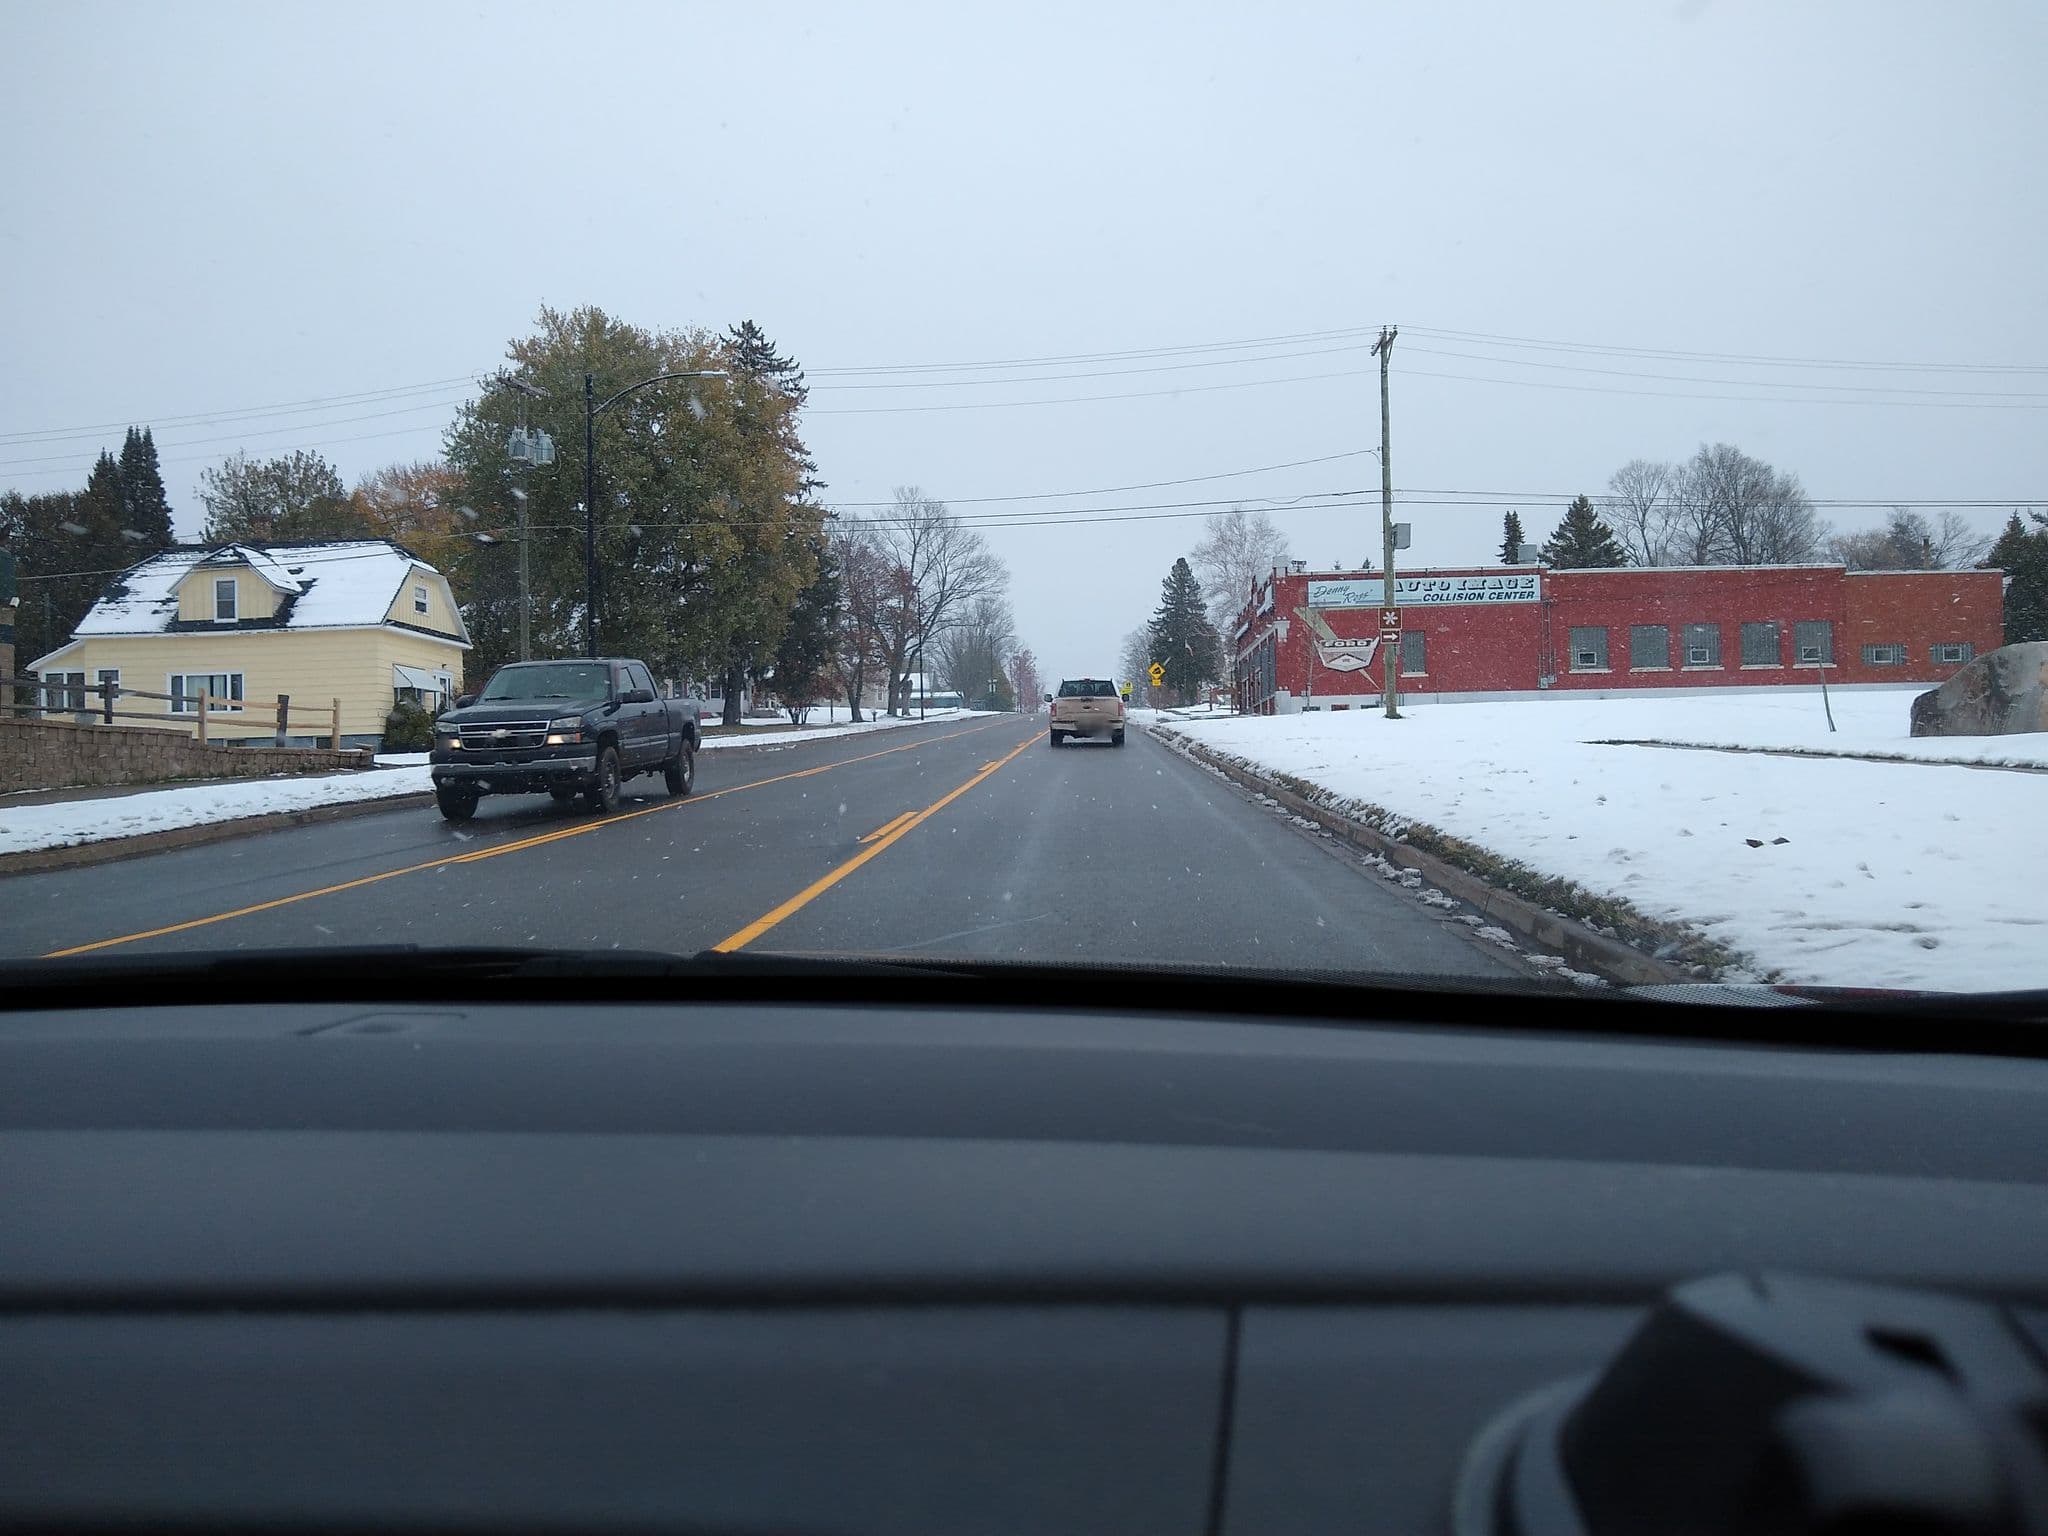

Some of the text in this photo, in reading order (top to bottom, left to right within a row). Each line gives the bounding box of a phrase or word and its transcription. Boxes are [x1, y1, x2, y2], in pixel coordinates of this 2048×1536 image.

[1457, 577, 1535, 590] IMAGE
[1313, 585, 1350, 598] Denny
[1422, 591, 1535, 602] COLLISION CENTER
